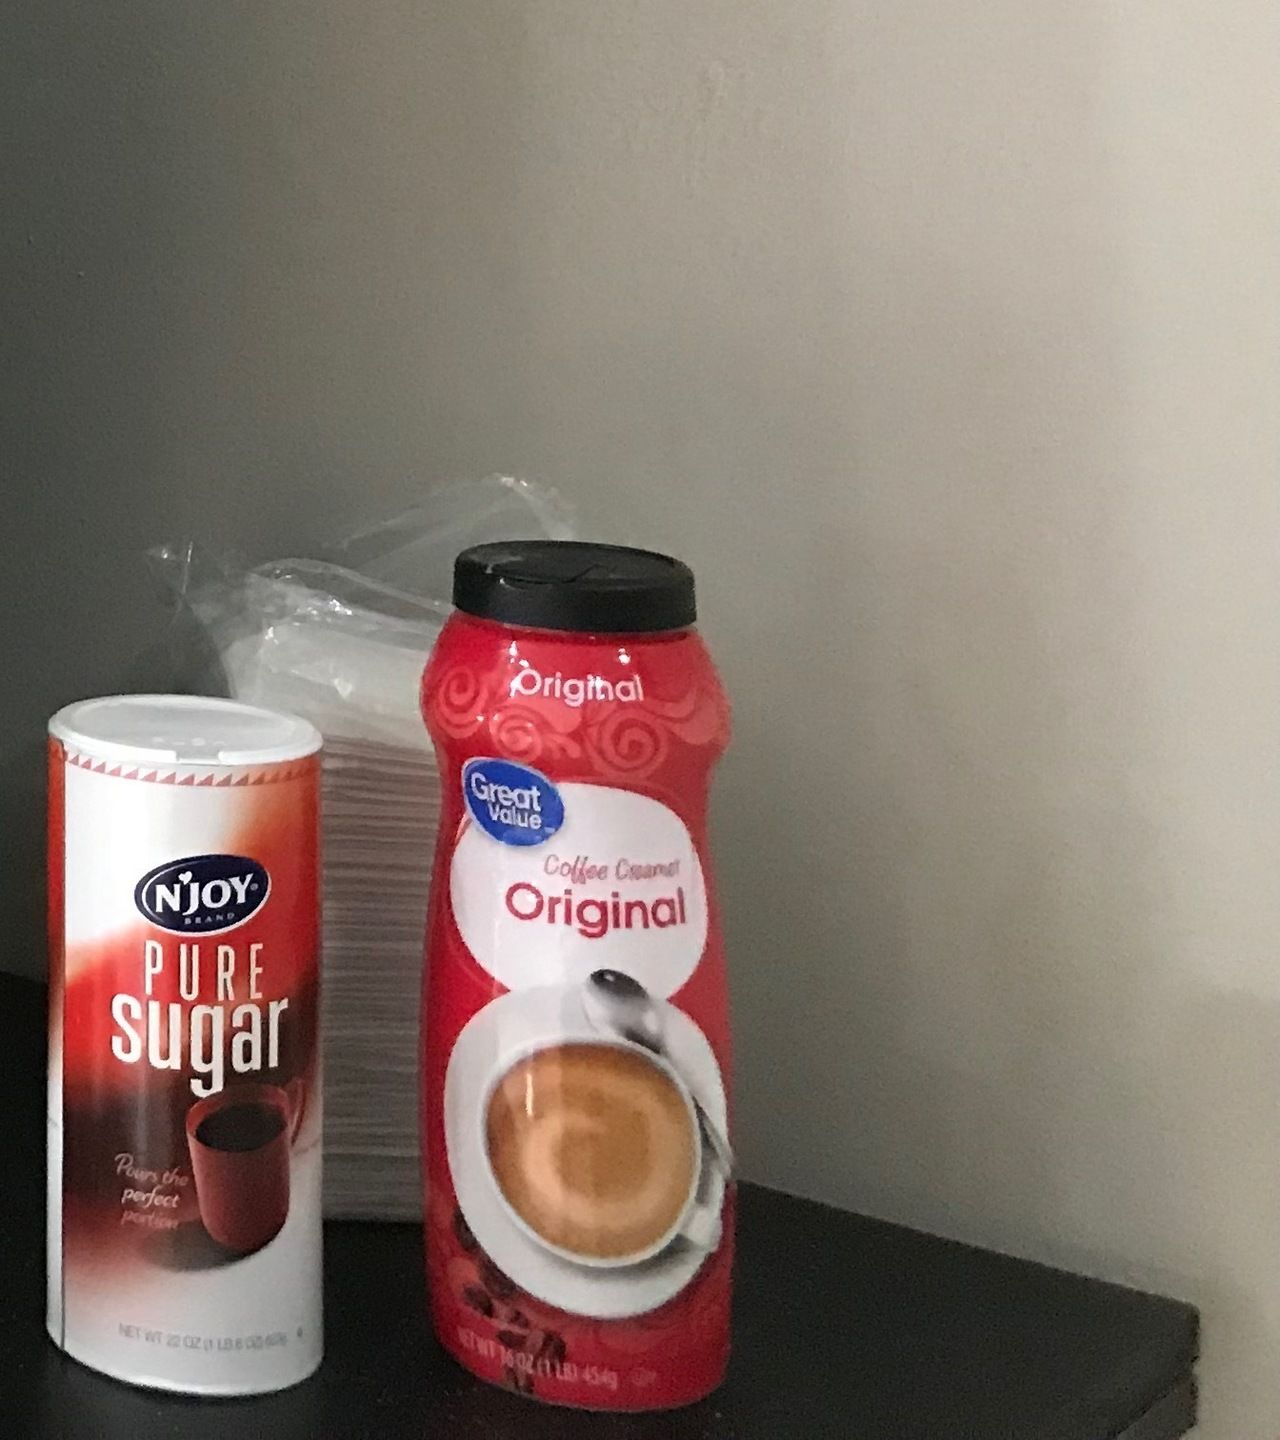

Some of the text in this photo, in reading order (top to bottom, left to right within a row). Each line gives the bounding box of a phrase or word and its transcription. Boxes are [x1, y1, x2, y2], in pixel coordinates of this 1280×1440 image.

[514, 668, 645, 707] Original
[470, 772, 541, 812] Great
[487, 803, 542, 830] Value
[544, 853, 608, 885] Coffee
[184, 912, 236, 926] BRAND
[505, 881, 687, 939] Original
[144, 939, 264, 1001] PURE
[111, 993, 289, 1098] sugar
[114, 1152, 190, 1187] Pours the
[120, 1184, 180, 1210] perfect
